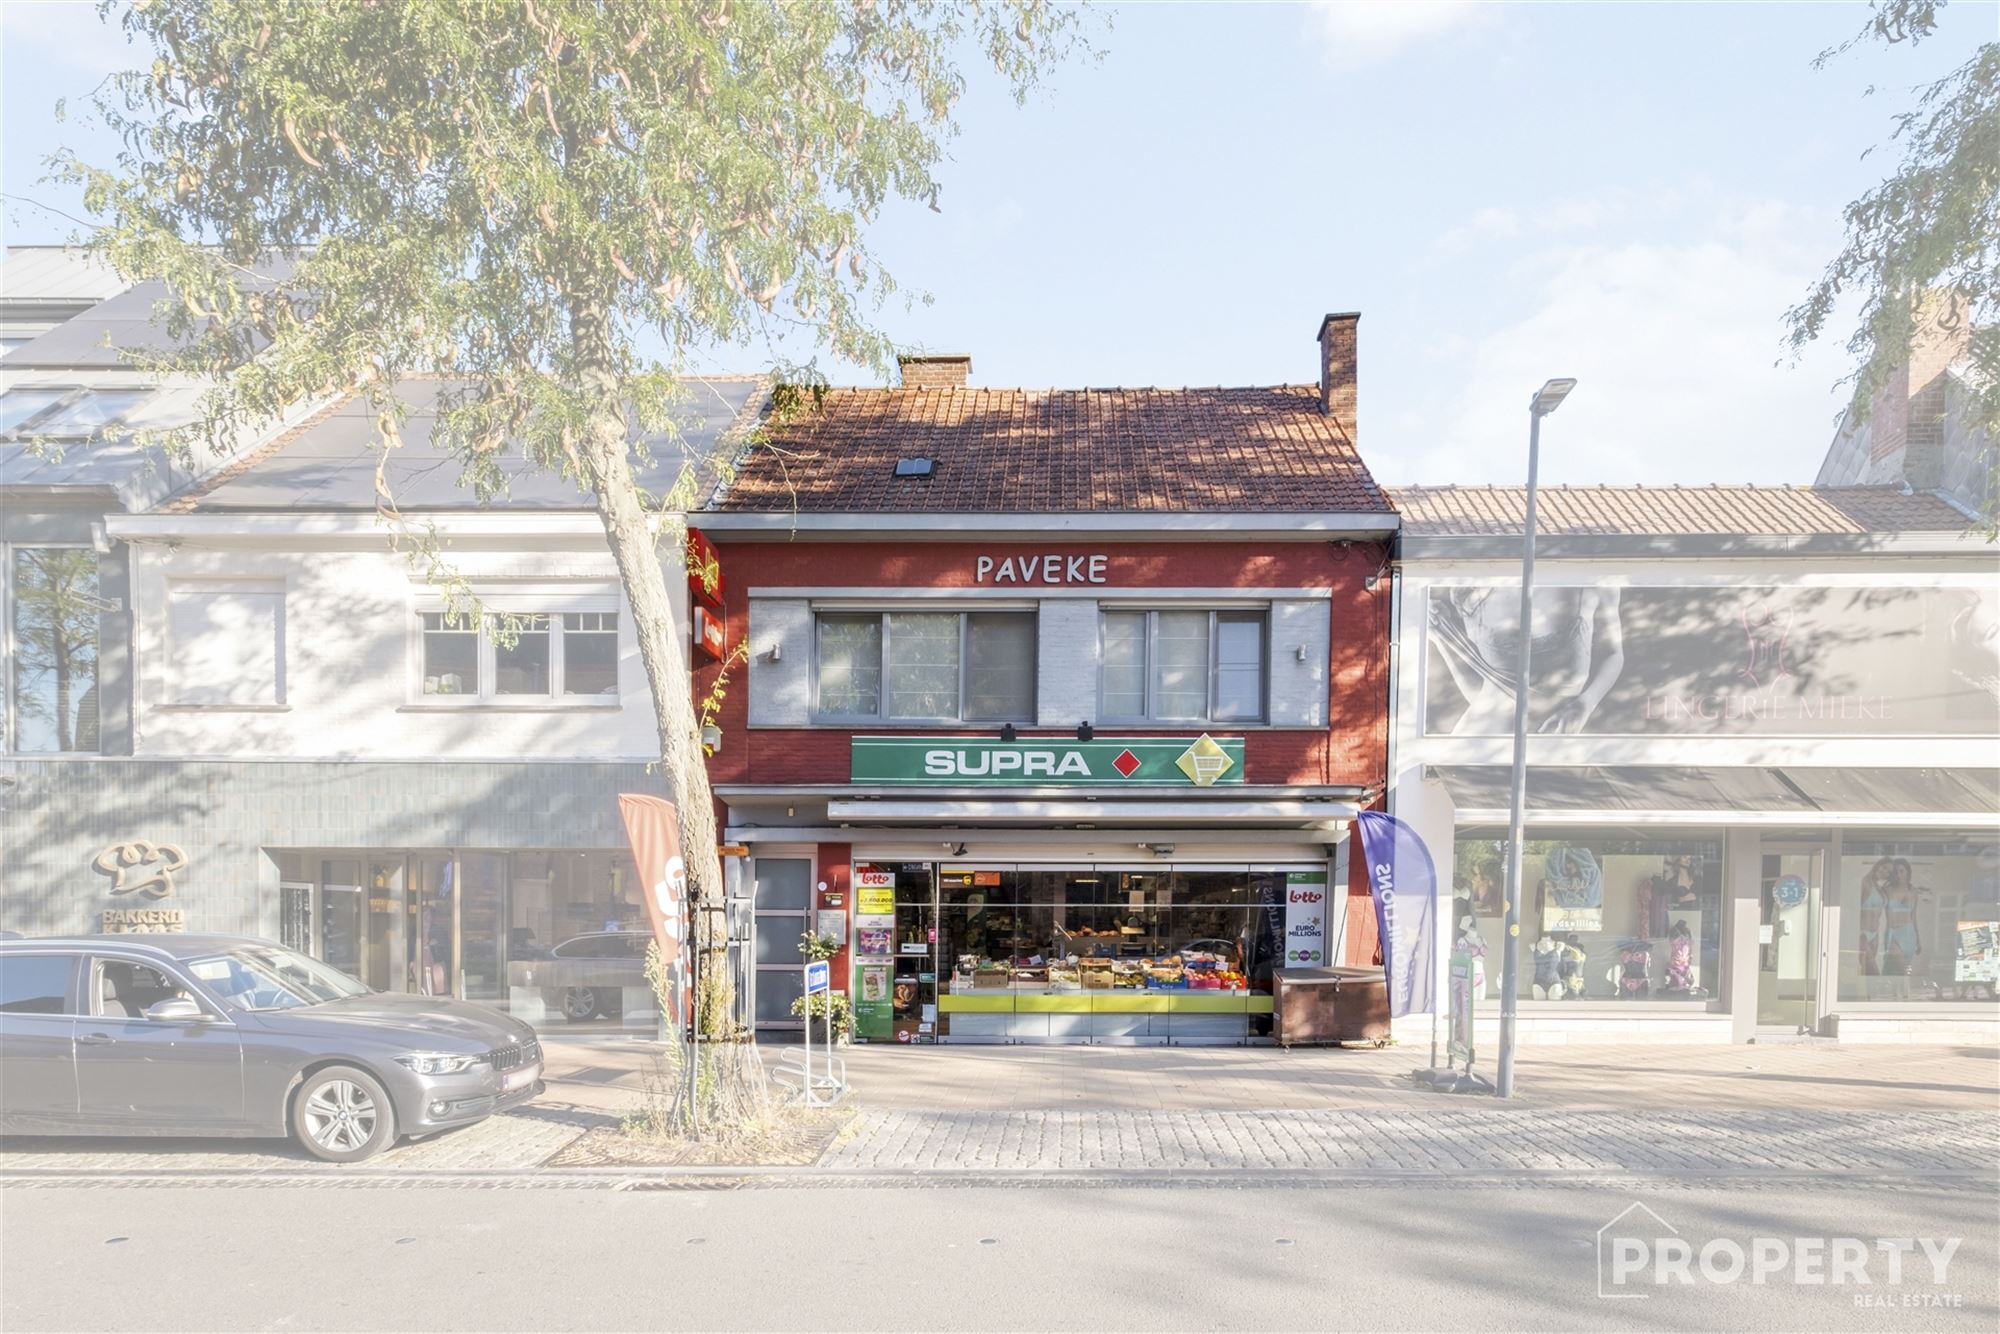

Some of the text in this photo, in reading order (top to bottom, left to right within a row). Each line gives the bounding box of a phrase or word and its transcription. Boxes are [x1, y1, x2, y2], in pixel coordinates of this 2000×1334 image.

[977, 555, 1108, 583] PAVEKE
[1645, 695, 1893, 720] LINGERIE MIEKE
[924, 750, 1092, 776] SUPRA
